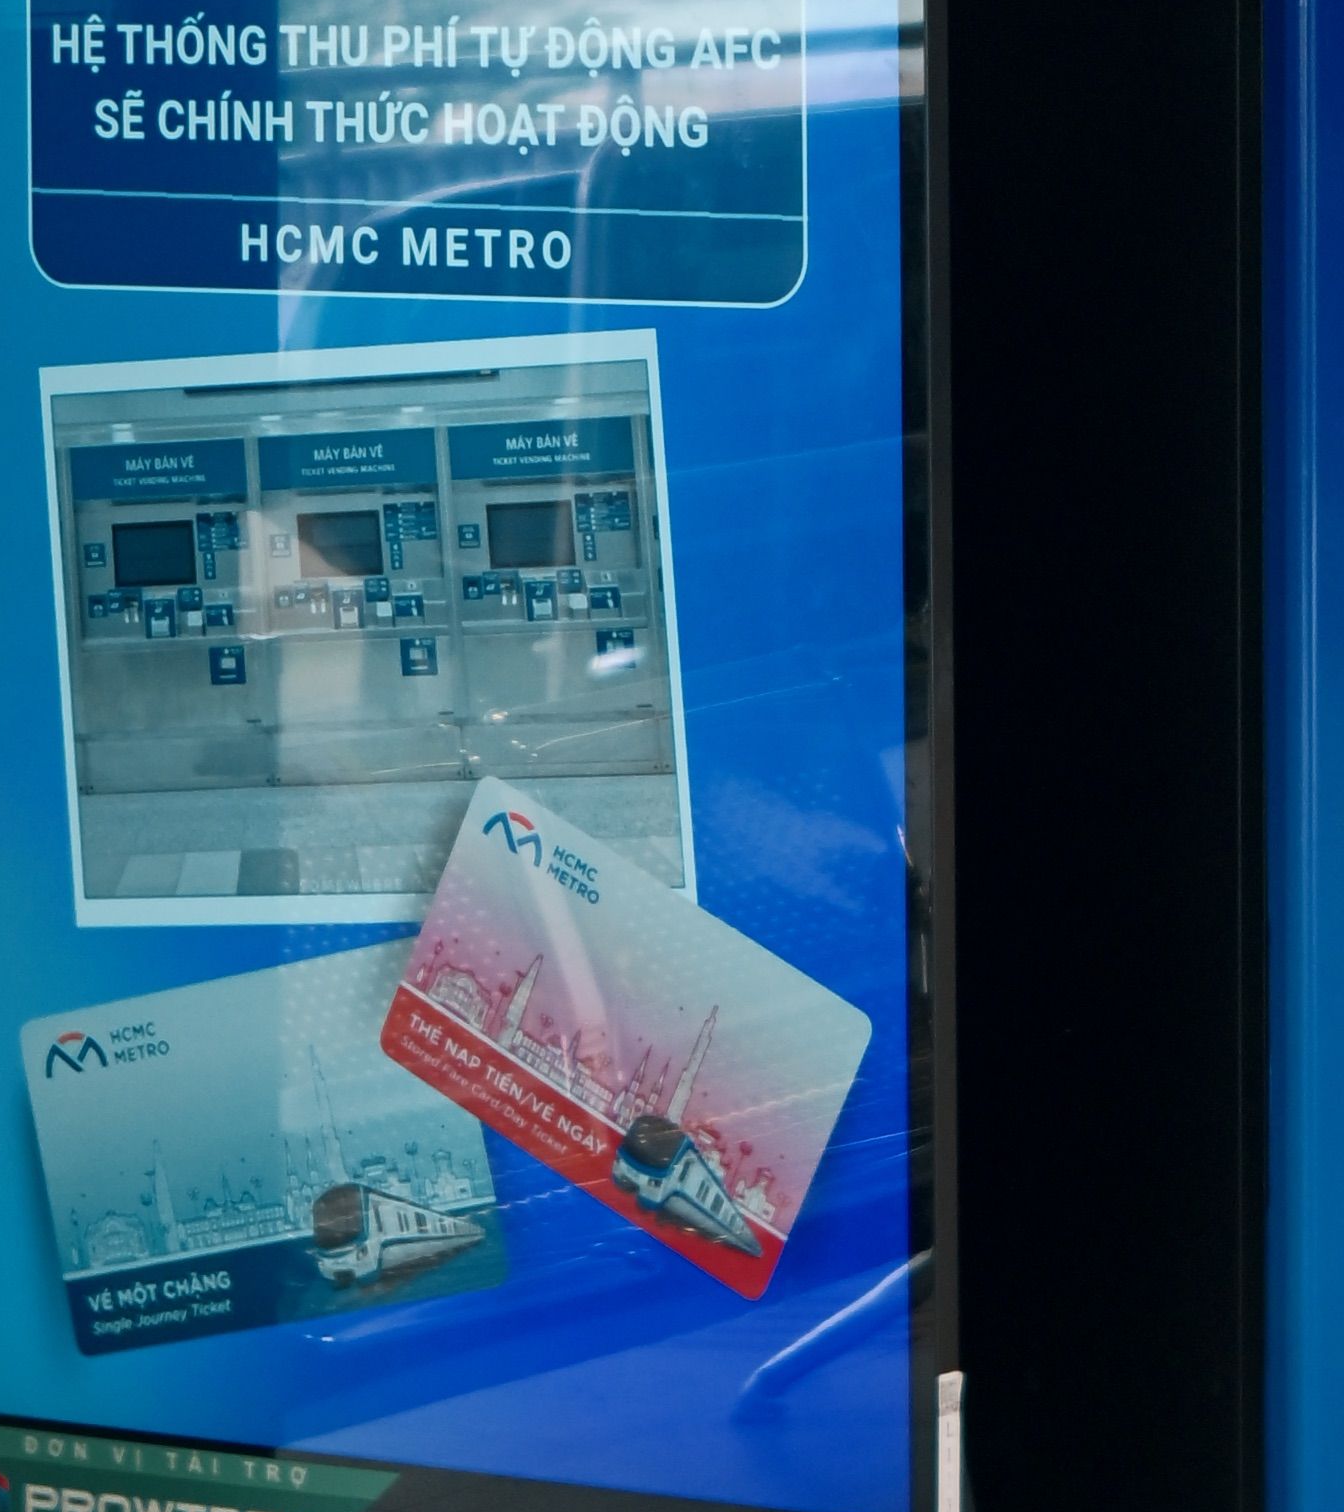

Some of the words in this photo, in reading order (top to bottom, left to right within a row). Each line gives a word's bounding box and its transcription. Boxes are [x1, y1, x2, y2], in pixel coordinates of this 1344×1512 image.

[51, 13, 107, 73] HỆ
[116, 11, 268, 67] THỐNG
[279, 23, 371, 68] THU
[383, 14, 461, 69] PHÍ
[469, 23, 532, 80] TỰ
[542, 16, 676, 81] ĐỘNG
[688, 26, 783, 71] AFC
[93, 90, 146, 140] SẼ
[156, 93, 294, 142] CHÍNH
[306, 91, 429, 144] THỨC
[442, 102, 561, 155] HOẠT
[575, 90, 710, 157] ĐỘNG
[239, 224, 381, 265] HCMC
[400, 226, 573, 270] METRO
[313, 446, 341, 462] MÁY
[506, 435, 533, 451] MÁY
[125, 456, 152, 472] MÁY
[546, 861, 600, 905] METRO
[552, 845, 598, 884] HCMC
[109, 1022, 157, 1044] HCMC
[113, 1039, 170, 1064] METRO
[444, 1035, 482, 1072] NẠP
[87, 1288, 114, 1312] VÉ
[117, 1281, 157, 1309] MỘT
[92, 1316, 133, 1337] Single
[135, 1307, 187, 1328] Journey
[191, 1298, 232, 1318] Ticket
[23, 1433, 89, 1461] ĐƠN
[242, 1460, 309, 1490] TRỢ
